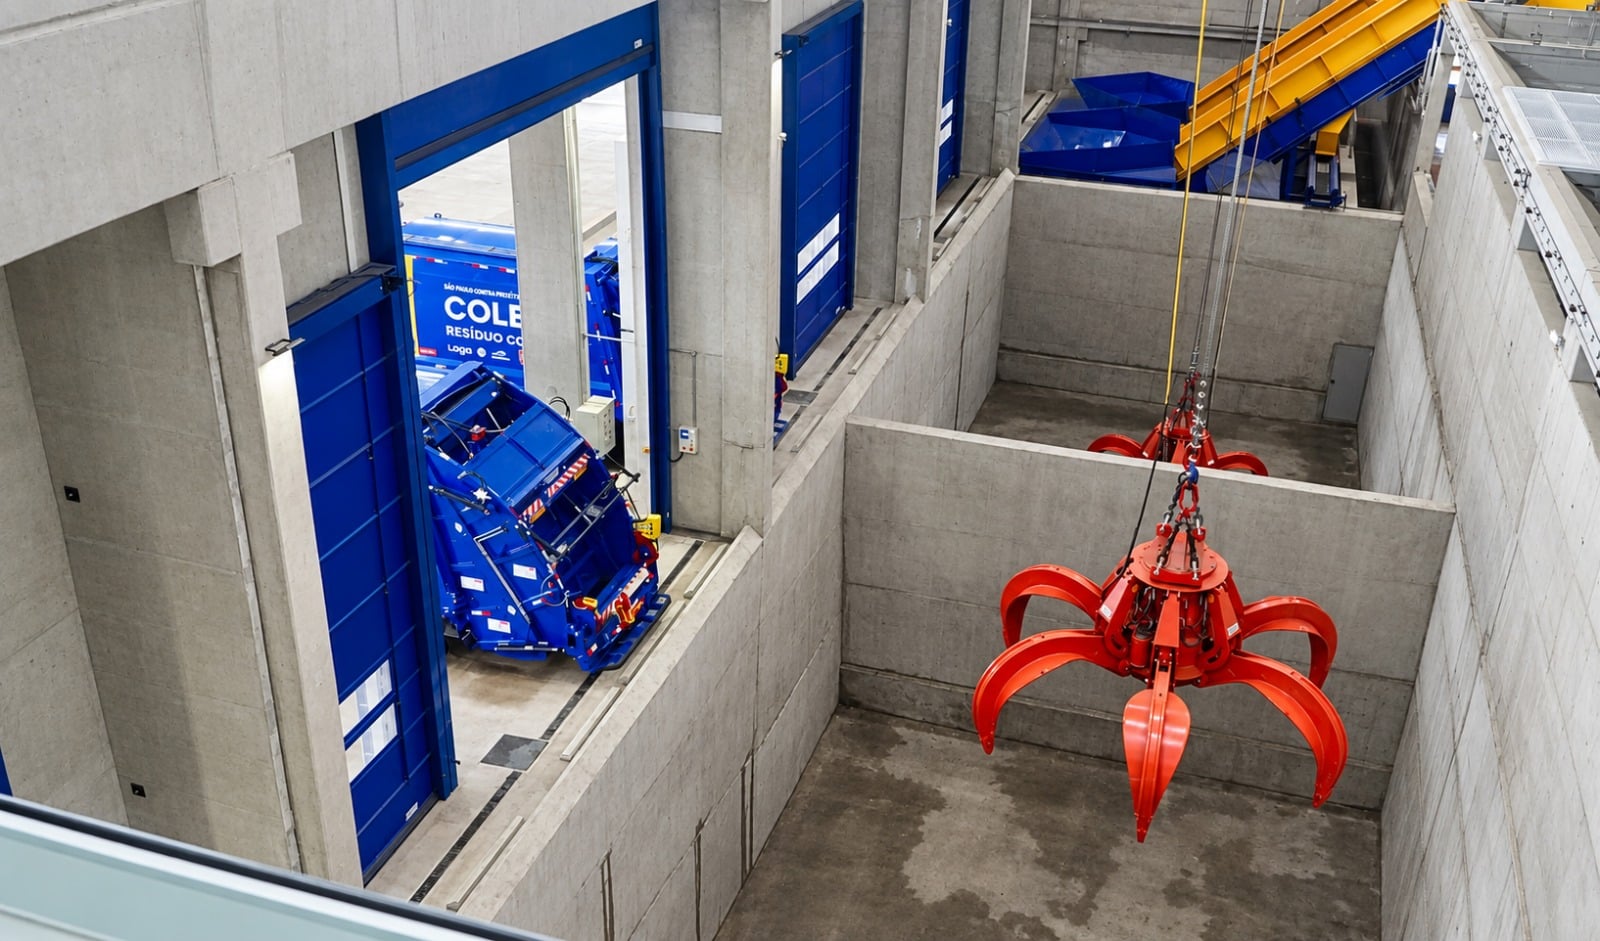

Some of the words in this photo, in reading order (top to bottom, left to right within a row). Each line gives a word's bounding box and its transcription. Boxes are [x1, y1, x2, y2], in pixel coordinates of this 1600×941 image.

[444, 295, 522, 329] COLE
[445, 325, 503, 343] RESÍDUO
[506, 335, 524, 347] CO
[447, 344, 473, 356] Loga
